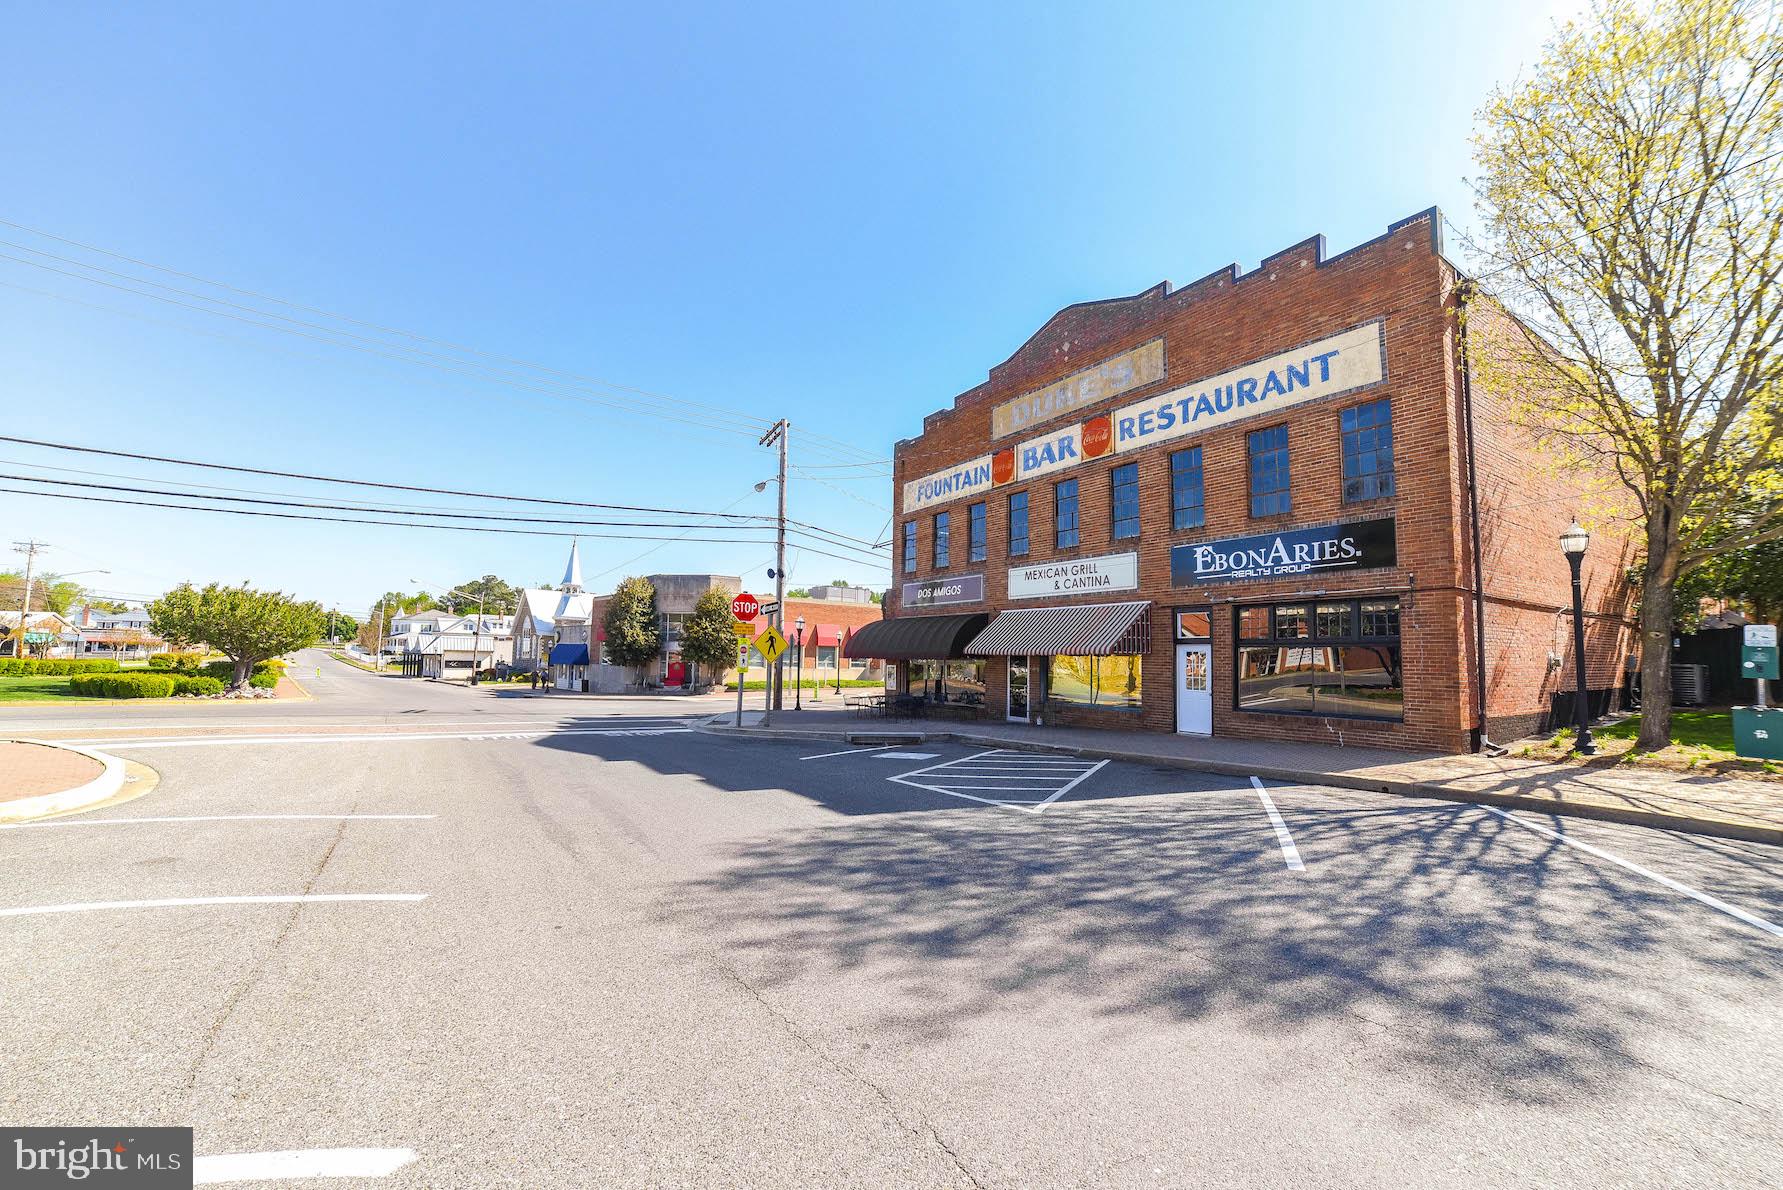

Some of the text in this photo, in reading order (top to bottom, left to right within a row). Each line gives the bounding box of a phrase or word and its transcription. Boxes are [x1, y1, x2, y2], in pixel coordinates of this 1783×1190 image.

[1119, 350, 1339, 442] RESTAURANT
[1023, 434, 1078, 472] BAR
[916, 463, 990, 502] FOUNTAIN
[1024, 563, 1098, 581] MEXICAN GRILL
[1231, 563, 1311, 579] REALTY GROUP
[1054, 574, 1111, 590] & CANTINA
[917, 584, 962, 599] DOS AMIGOS
[733, 601, 758, 614] STOP
